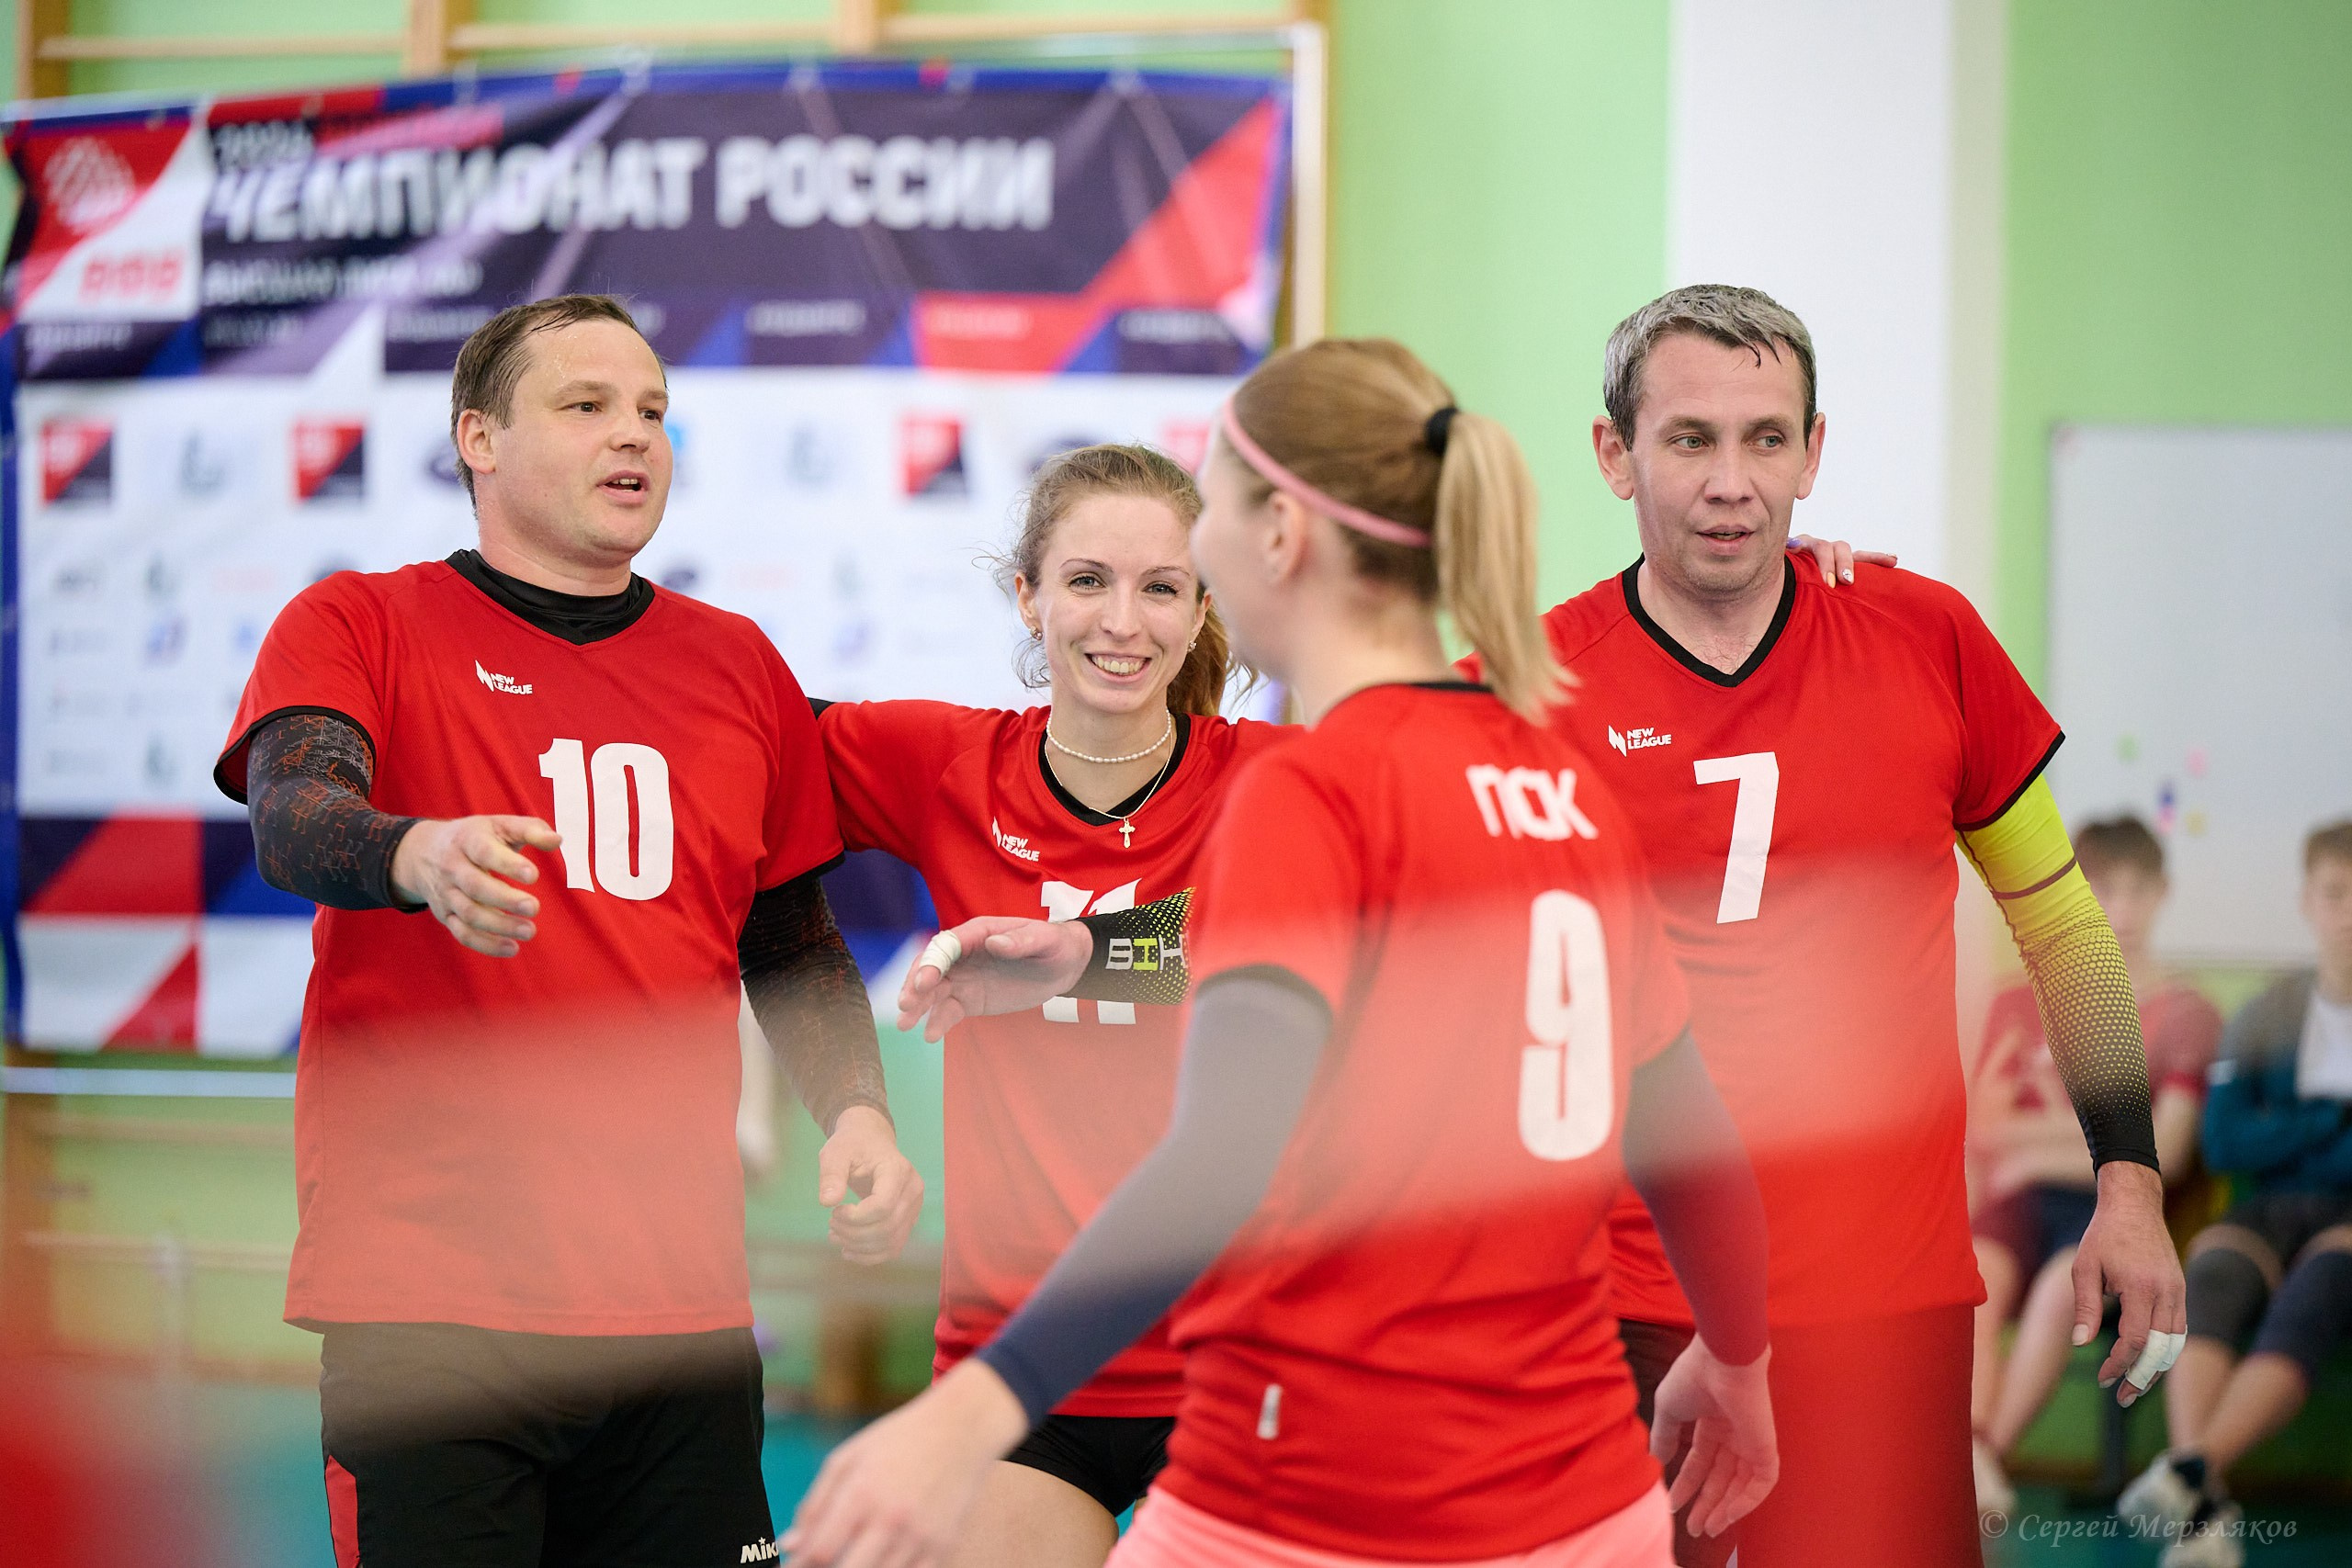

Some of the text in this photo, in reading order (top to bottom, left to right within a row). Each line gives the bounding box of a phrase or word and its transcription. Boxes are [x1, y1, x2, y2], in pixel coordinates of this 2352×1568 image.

[211, 134, 1054, 243] ЧЕМПИОНАТ РОССИИ
[490, 672, 514, 685] NEW
[493, 681, 533, 694] LEAGUE
[1627, 728, 1654, 739] NEW
[1628, 734, 1672, 750] LEAGUE
[538, 738, 673, 901] 10
[1002, 833, 1029, 849] NEW
[1693, 751, 1780, 924] 7
[1001, 842, 1041, 862] LEAGUE
[1518, 888, 1615, 1161] 9
